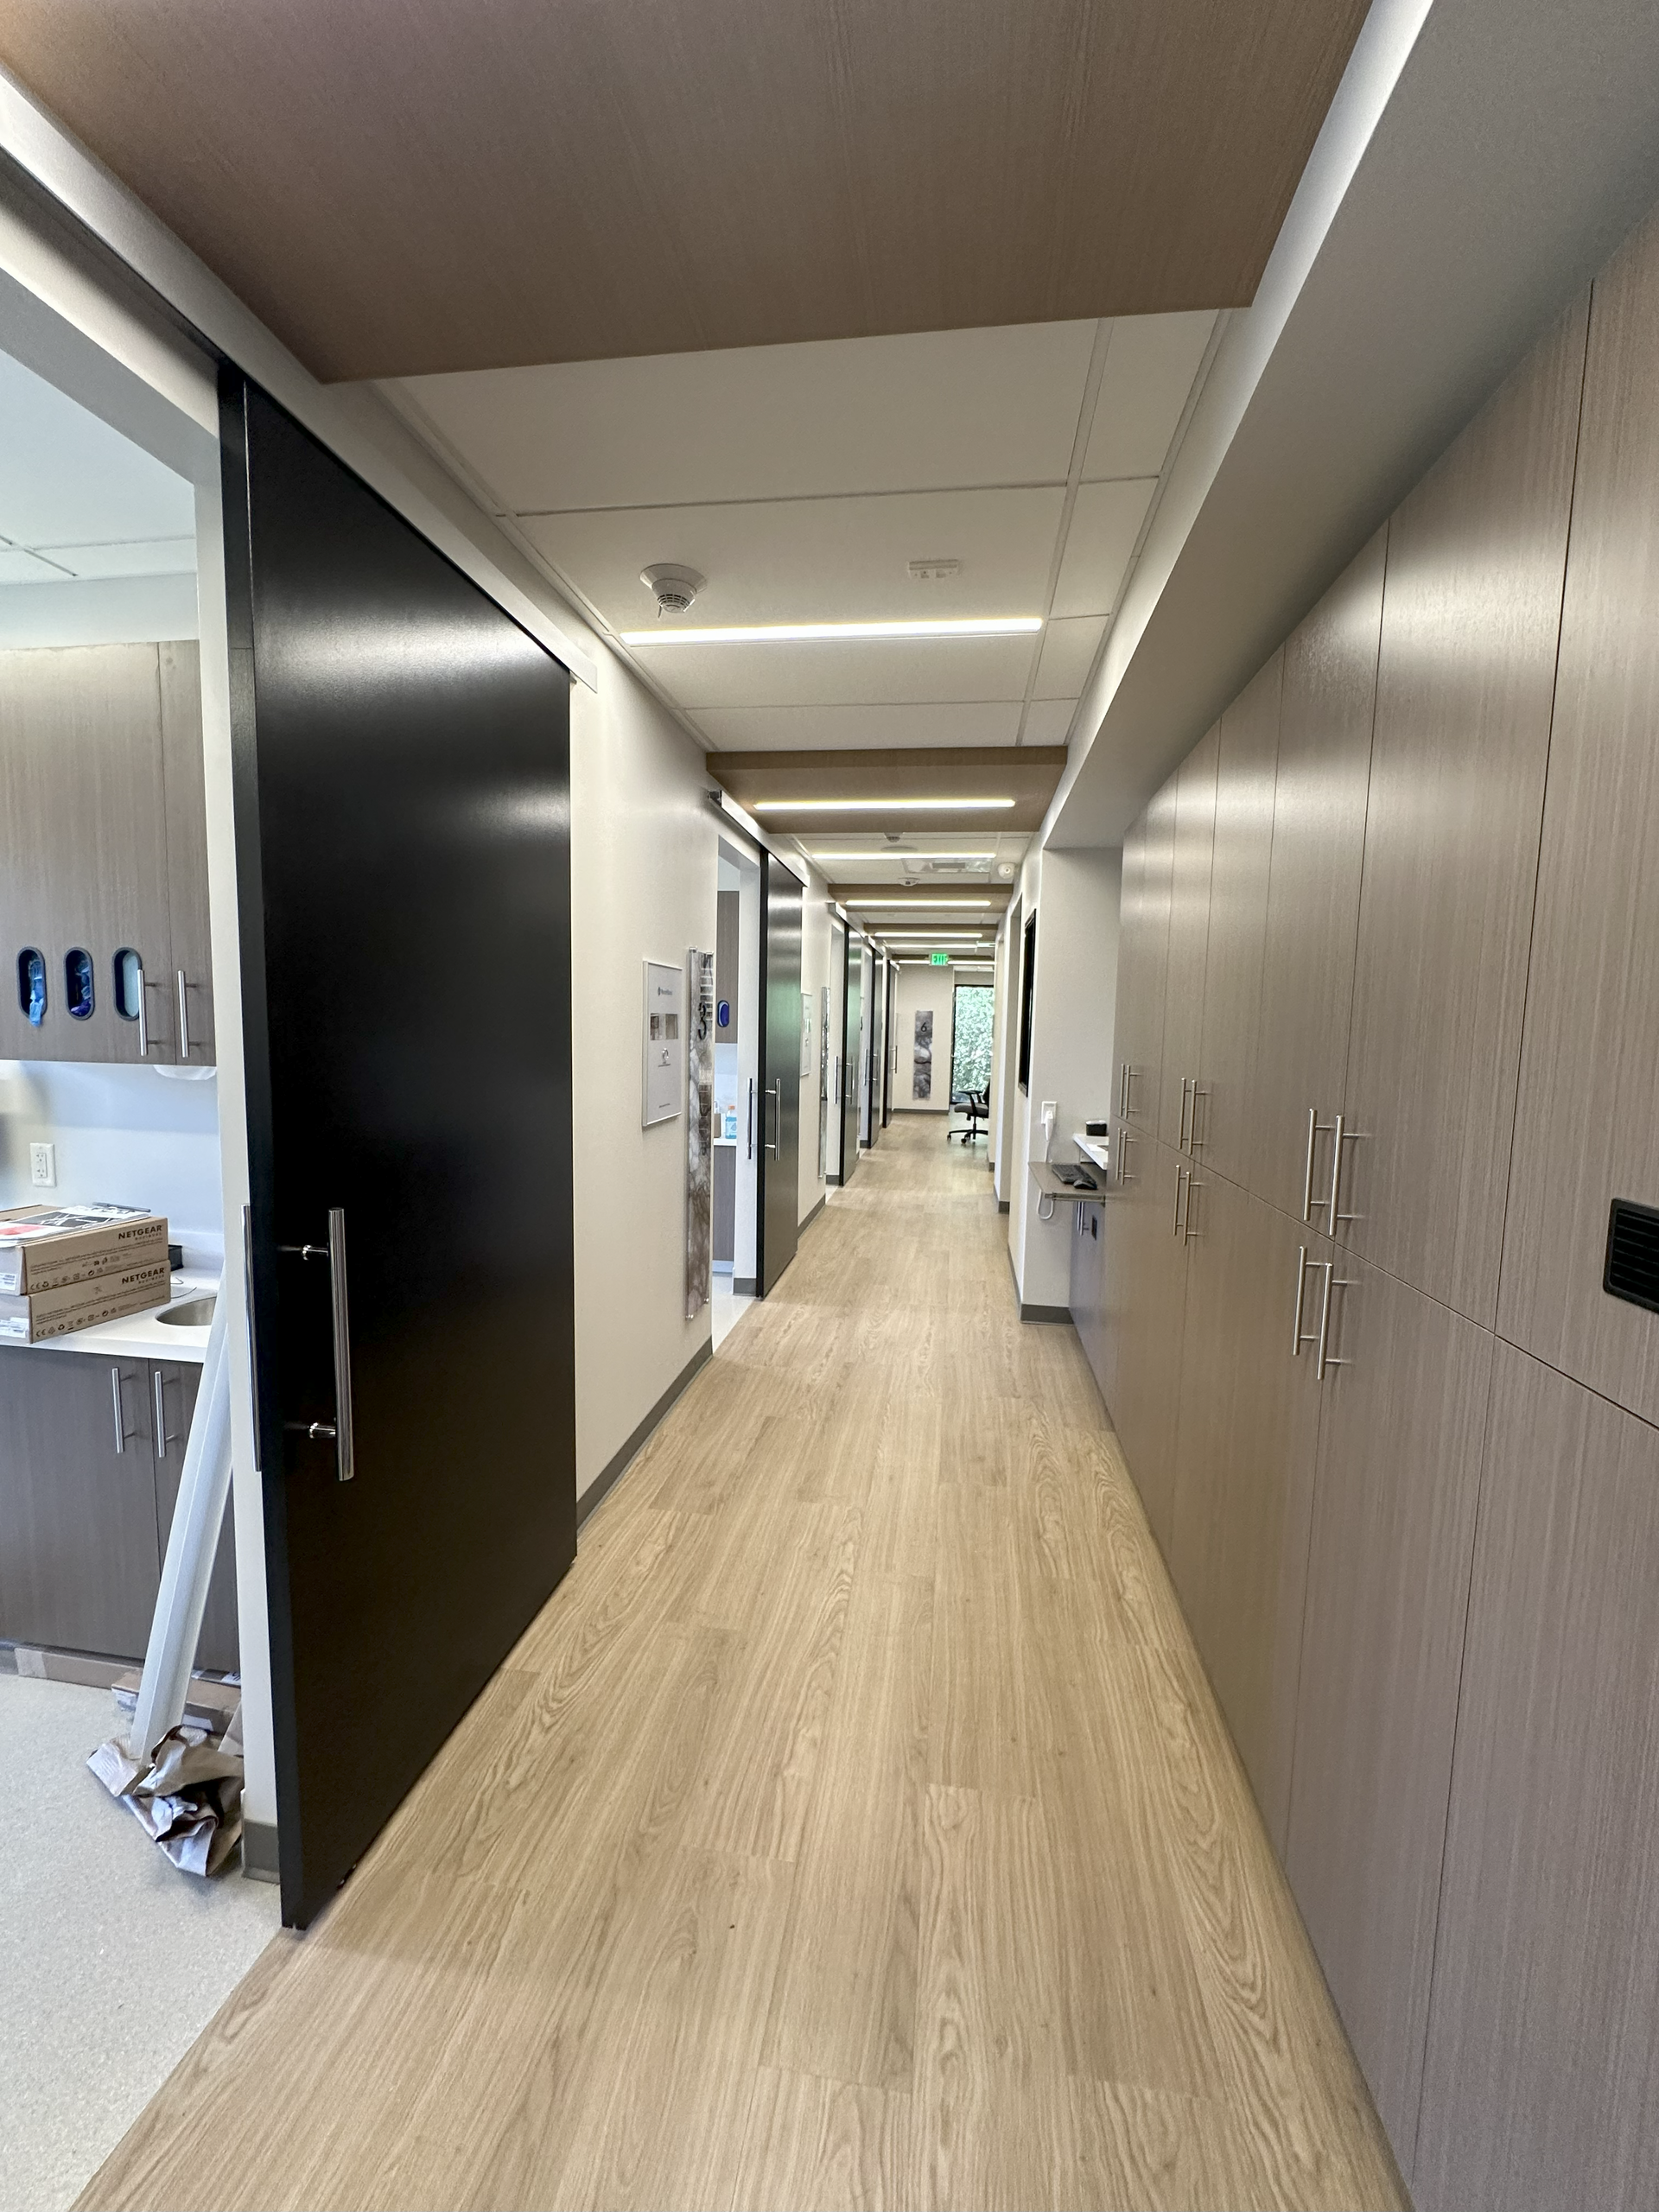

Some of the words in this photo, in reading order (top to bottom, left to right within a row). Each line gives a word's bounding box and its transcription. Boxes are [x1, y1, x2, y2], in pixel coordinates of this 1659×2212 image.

[698, 1002, 707, 1040] 3
[920, 1021, 927, 1033] 6
[118, 1224, 162, 1239] NETGEAR
[122, 1267, 164, 1284] NETGEAR
